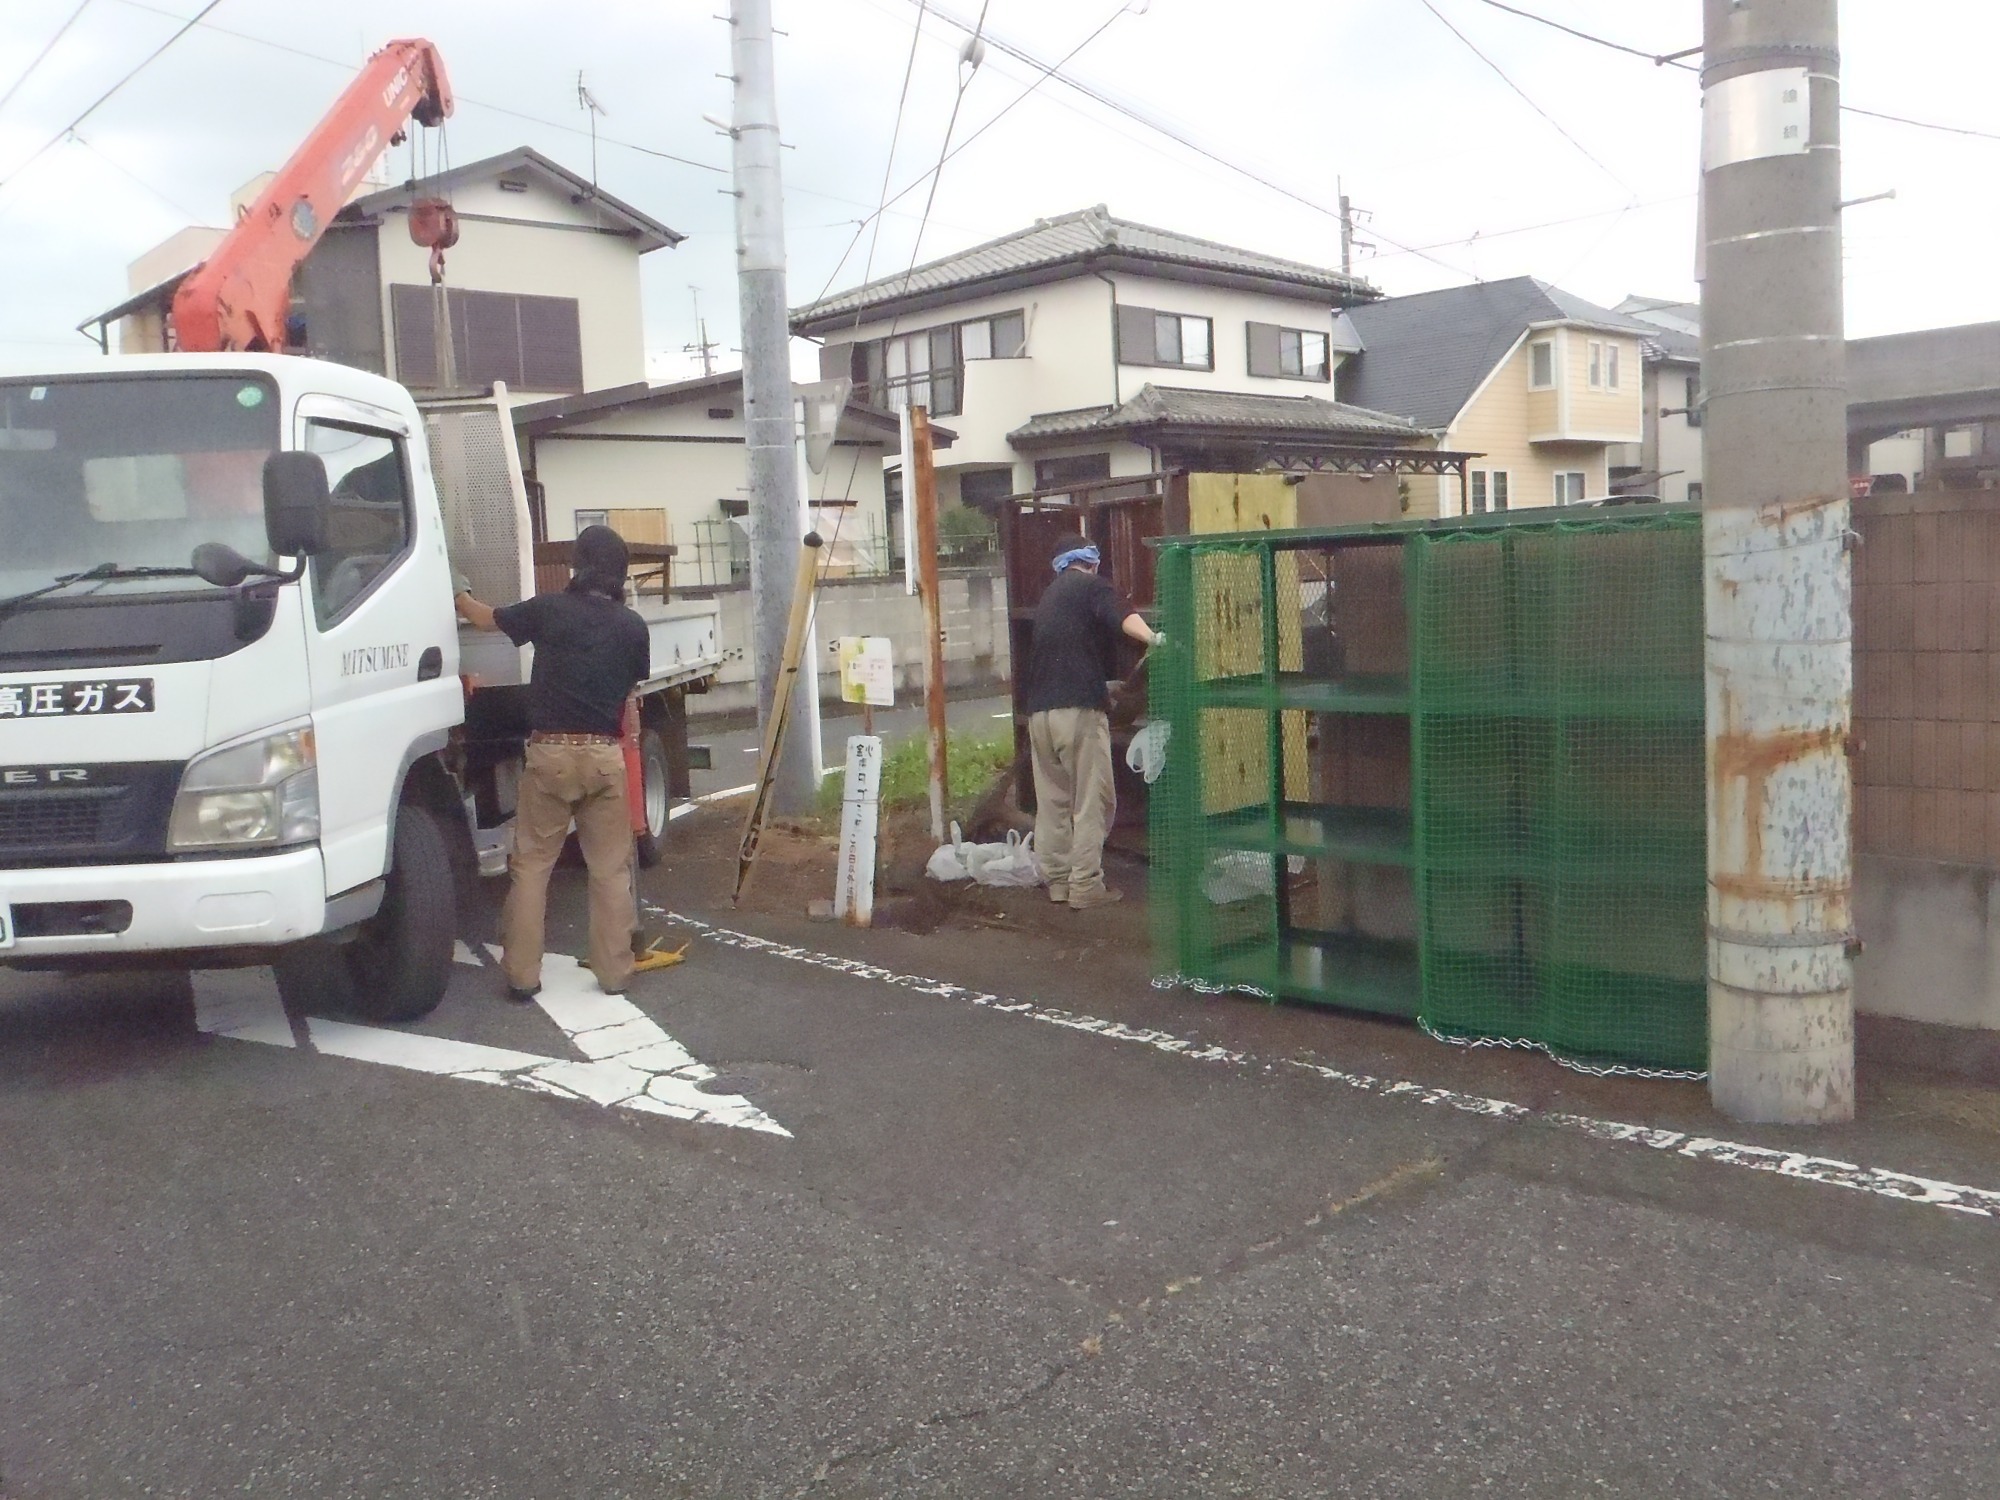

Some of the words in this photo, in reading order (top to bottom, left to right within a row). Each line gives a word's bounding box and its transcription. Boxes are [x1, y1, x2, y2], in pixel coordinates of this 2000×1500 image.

[0, 683, 146, 716] 高圧ガス
[4, 768, 88, 783] ER
